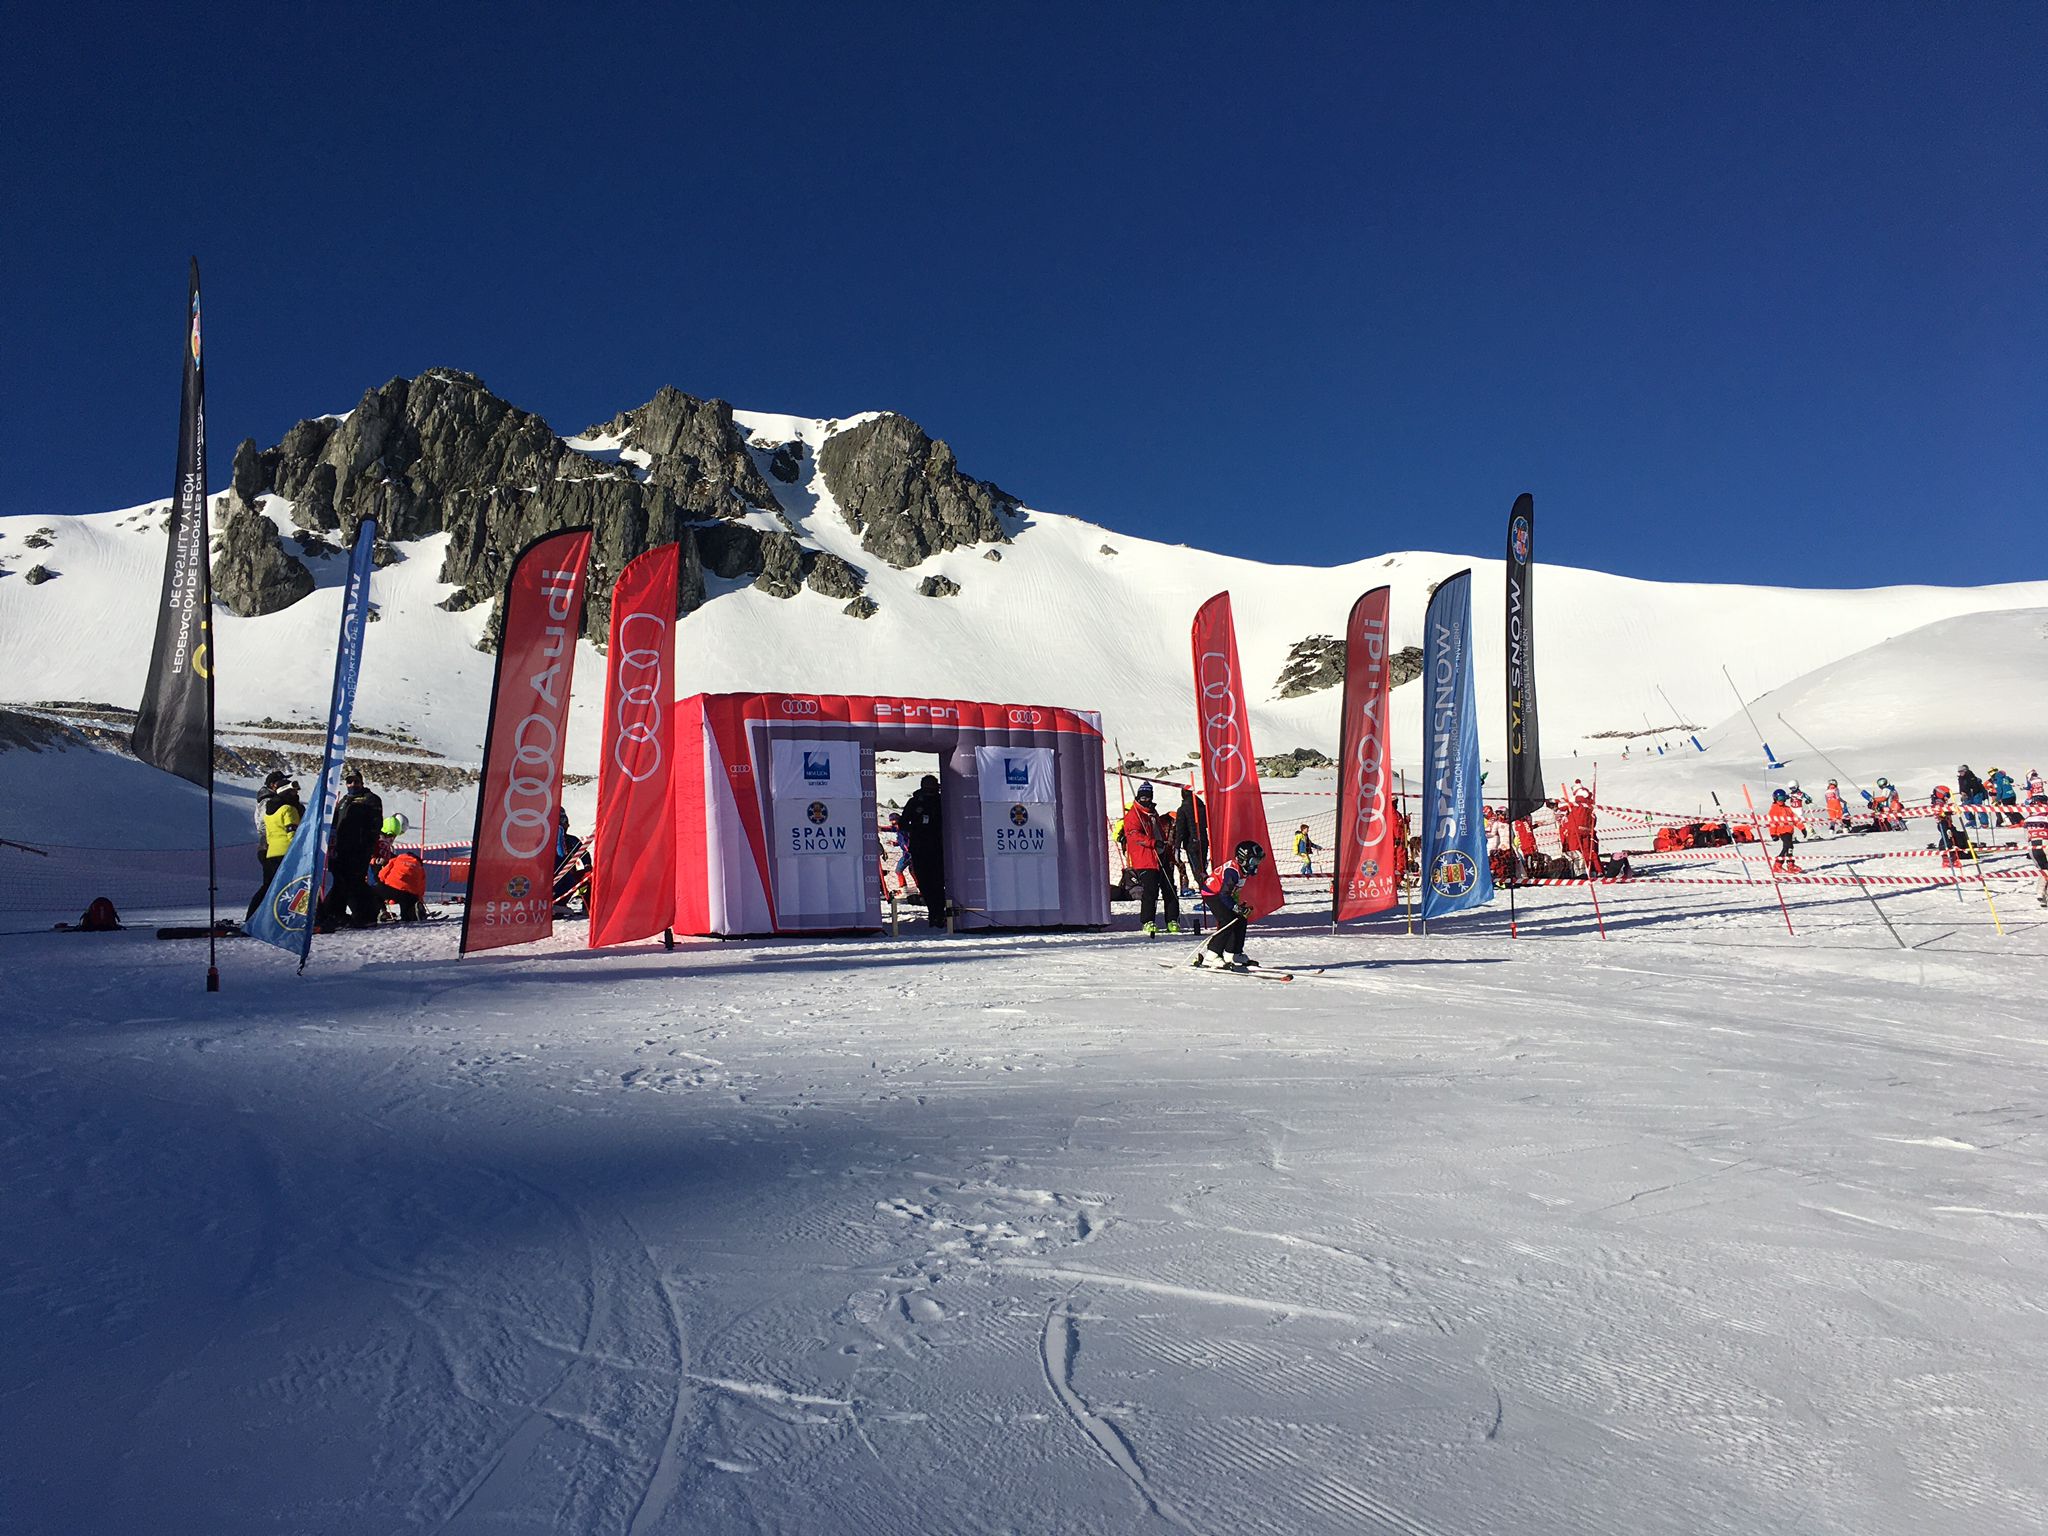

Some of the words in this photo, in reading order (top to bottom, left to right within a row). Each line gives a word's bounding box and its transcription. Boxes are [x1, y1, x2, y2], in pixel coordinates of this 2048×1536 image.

[530, 569, 577, 708] Audi
[1362, 618, 1384, 729] Audi
[1510, 578, 1521, 755] CYLSNOW
[1523, 660, 1532, 700] CASTILLA
[874, 703, 960, 719] e-tron
[1434, 623, 1457, 839] SPAINSNOW
[791, 826, 847, 839] SPAIN
[996, 828, 1044, 839] SPAIN
[1458, 815, 1468, 836] REAL
[791, 838, 847, 851] SNOW
[997, 839, 1045, 851] SNOW
[1348, 875, 1393, 890] SPAIN
[1348, 884, 1393, 900] SNOW
[486, 900, 549, 914] SPAIN
[484, 911, 548, 926] SNOW
